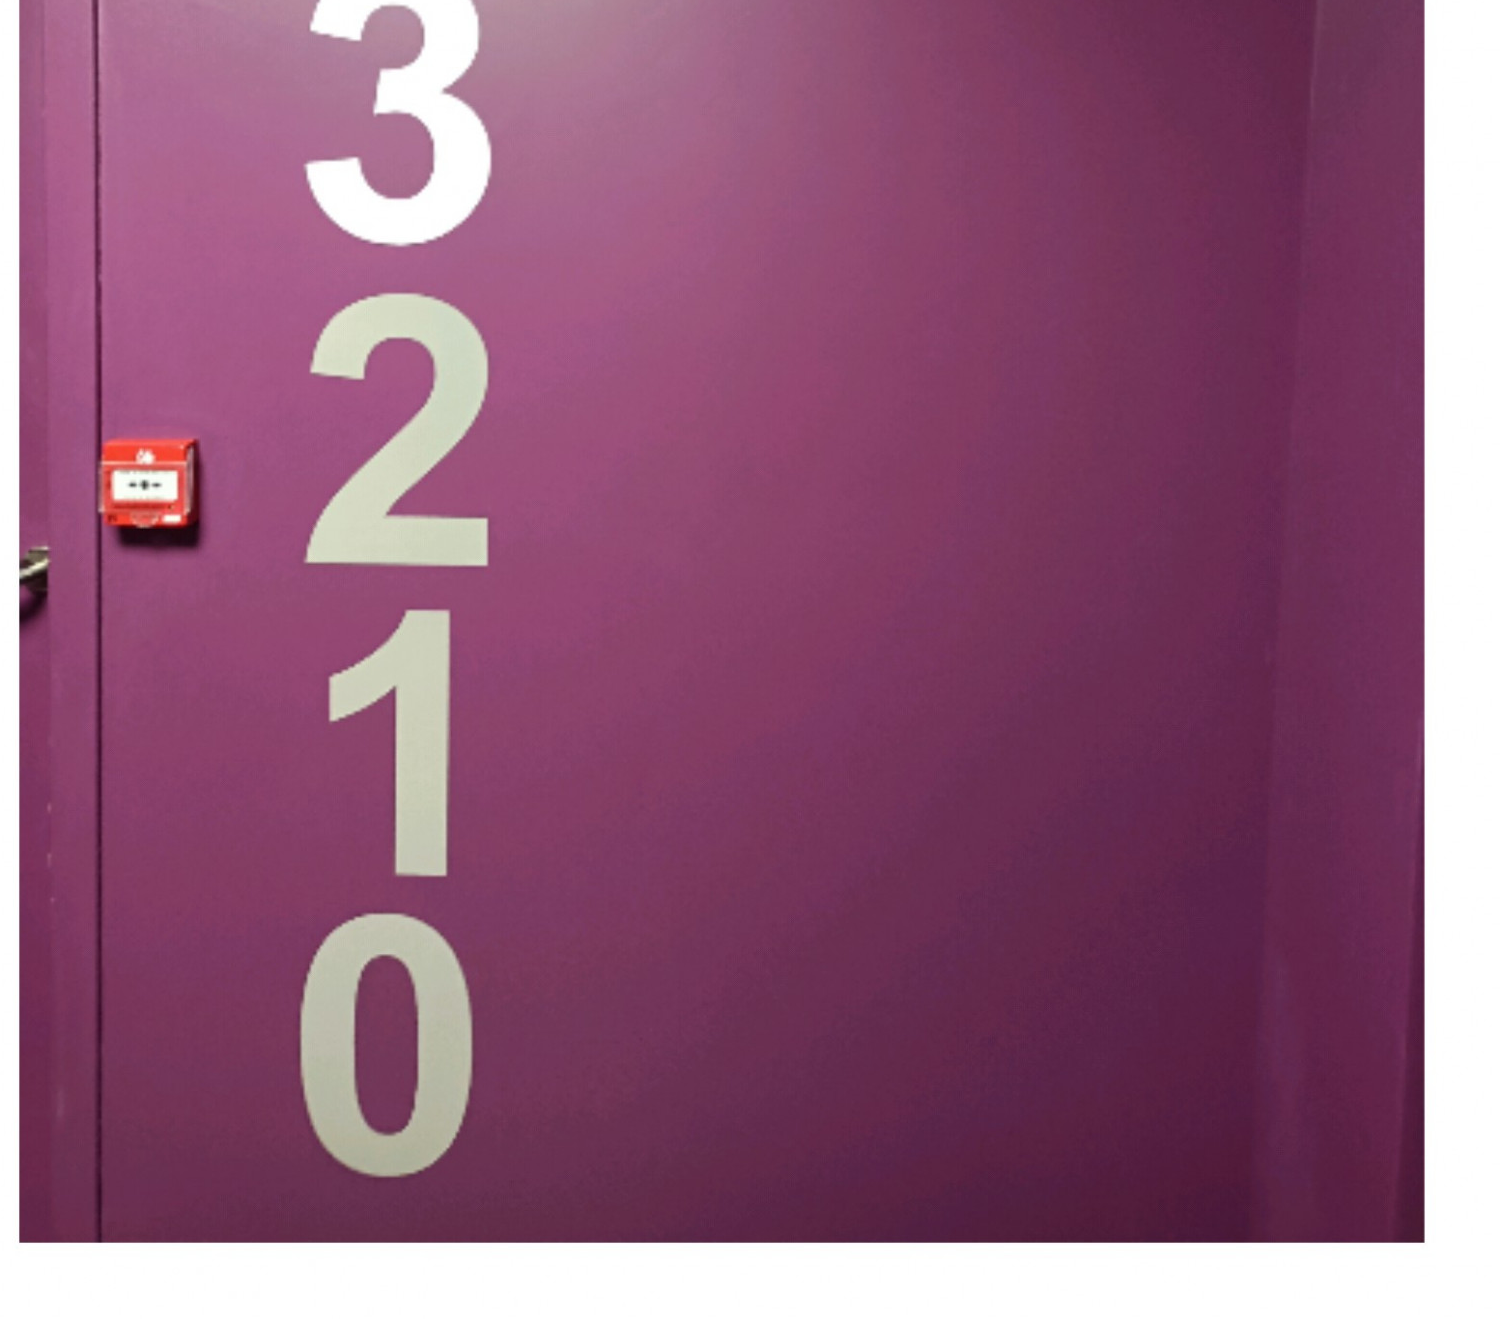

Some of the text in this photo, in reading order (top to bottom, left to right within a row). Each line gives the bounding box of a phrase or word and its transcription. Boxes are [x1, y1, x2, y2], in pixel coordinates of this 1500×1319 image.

[305, 293, 489, 566] 2
[328, 609, 450, 877] 1
[300, 912, 473, 1177] 0
